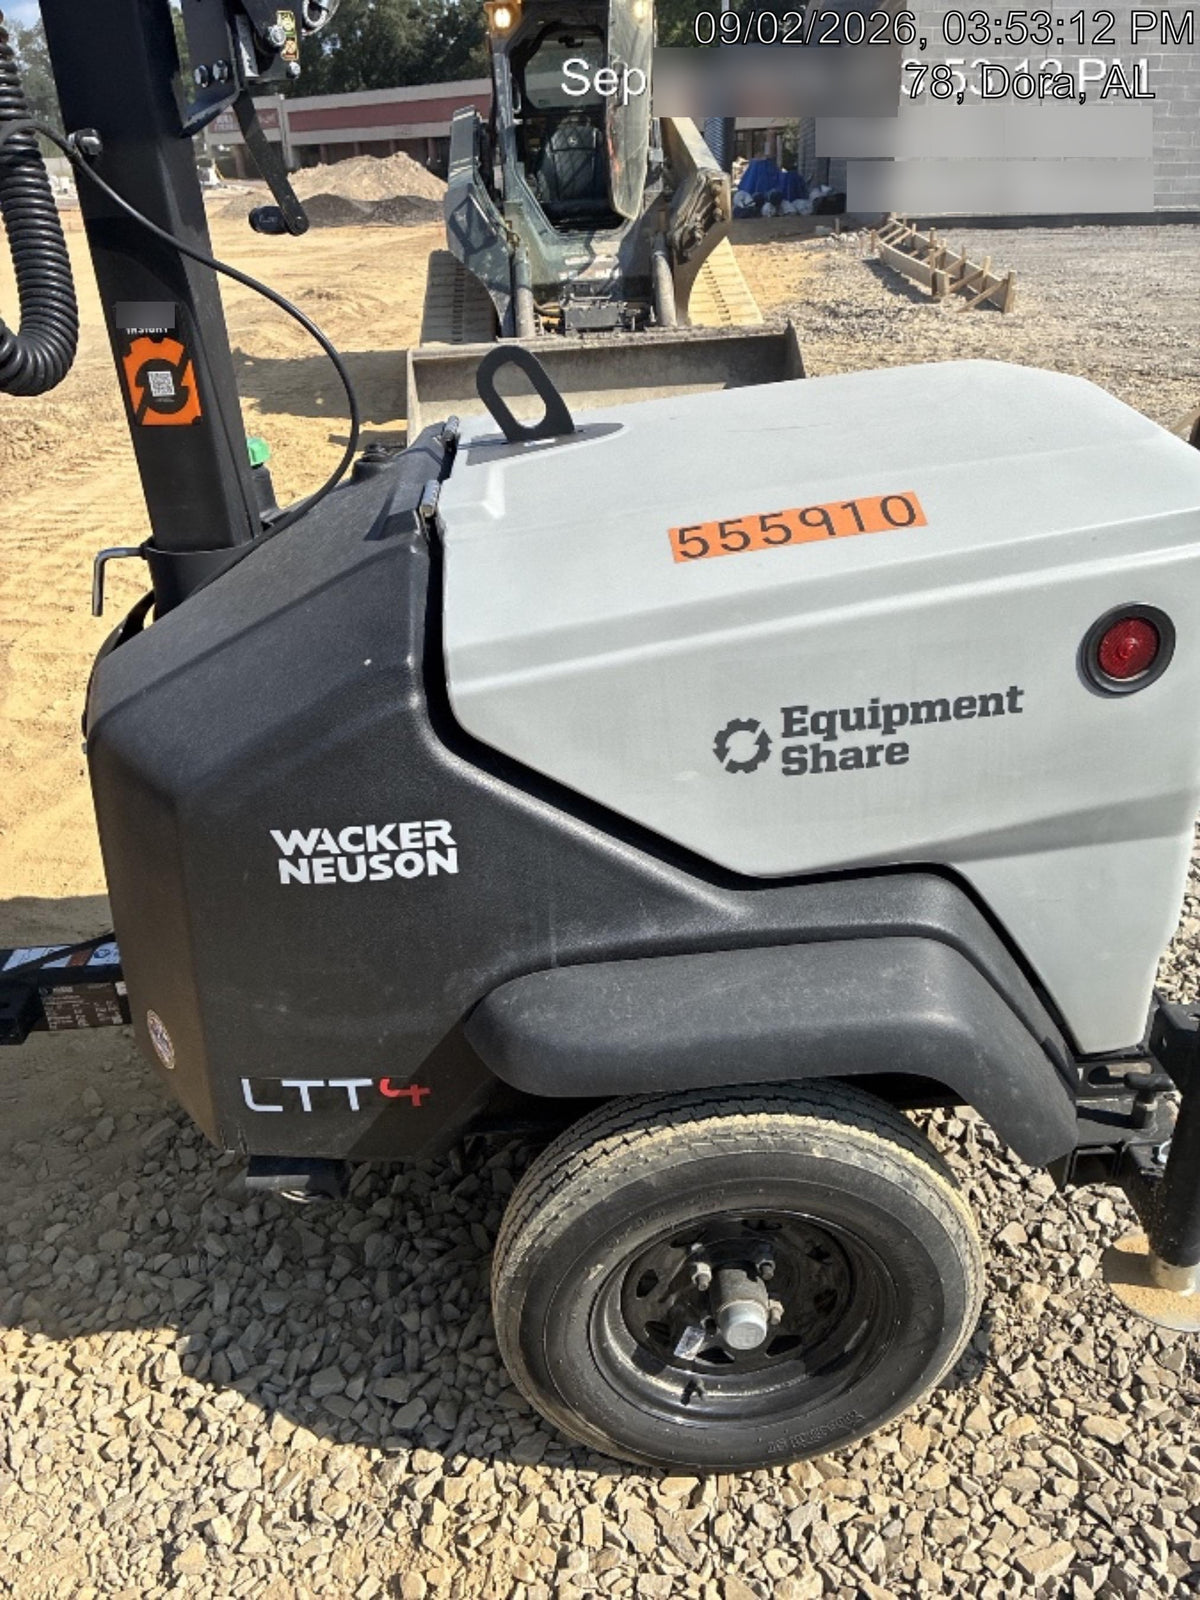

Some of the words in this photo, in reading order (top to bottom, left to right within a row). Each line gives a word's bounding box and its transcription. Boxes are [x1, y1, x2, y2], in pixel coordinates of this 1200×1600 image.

[678, 495, 916, 559] 555910
[780, 685, 1024, 741] Equipment
[781, 741, 909, 776] Share
[269, 819, 457, 856] WACKER
[278, 848, 459, 884] NEUSON
[241, 1078, 431, 1111] LTT4
